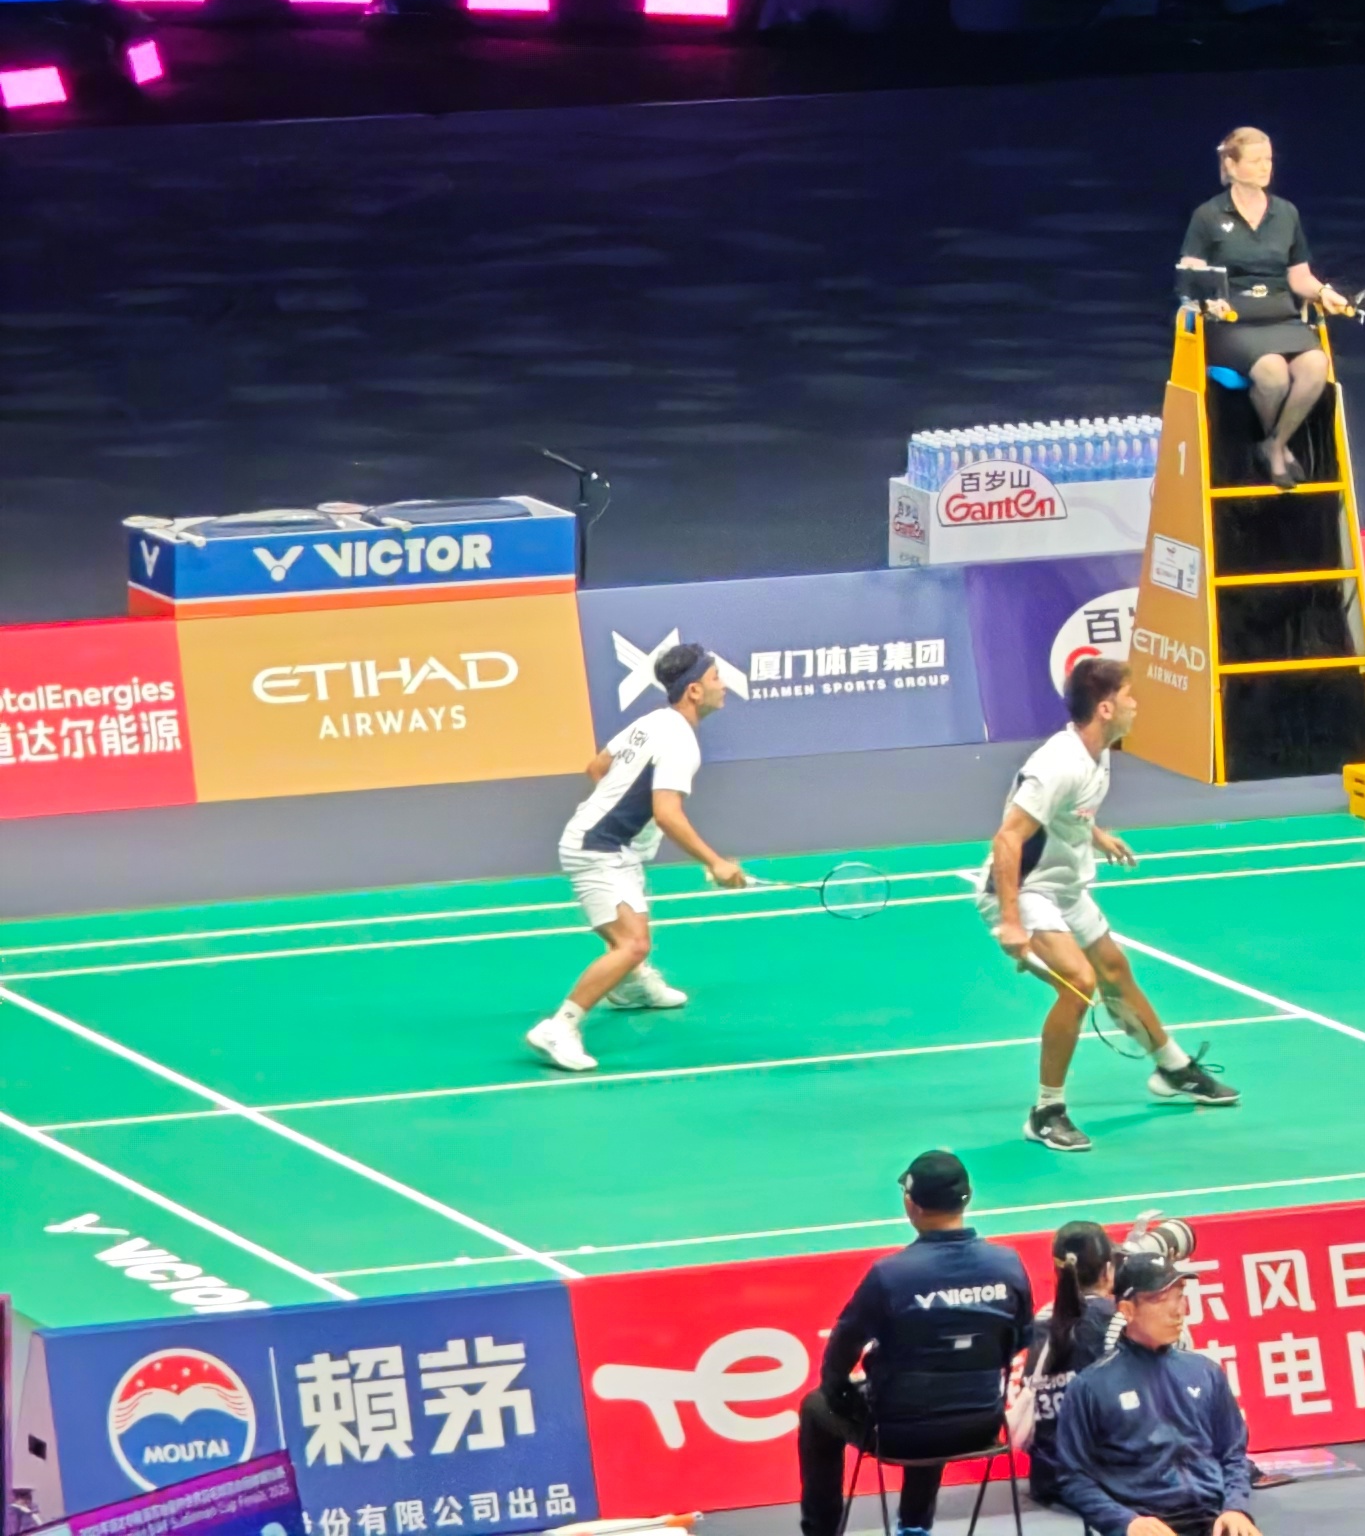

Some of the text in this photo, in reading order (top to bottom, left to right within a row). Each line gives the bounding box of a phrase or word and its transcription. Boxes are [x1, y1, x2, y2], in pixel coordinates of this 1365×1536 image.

[1178, 440, 1187, 477] 1
[960, 468, 1031, 493] 百岁山
[313, 532, 494, 578] VICTOR
[750, 638, 946, 682] 厦门体育集团
[1132, 627, 1207, 672] ETIHAD
[0, 676, 176, 713] talEnergies
[252, 650, 519, 705] ETIHAD
[752, 673, 951, 700] XIAMEN SPORTS GROUP
[1146, 663, 1190, 692] AIRWAYS
[318, 704, 468, 741] AIRWAYS
[936, 1283, 1007, 1306] VICTOR
[143, 1438, 231, 1465] MOUTAI
[302, 1482, 577, 1536] 份有限公司出品
